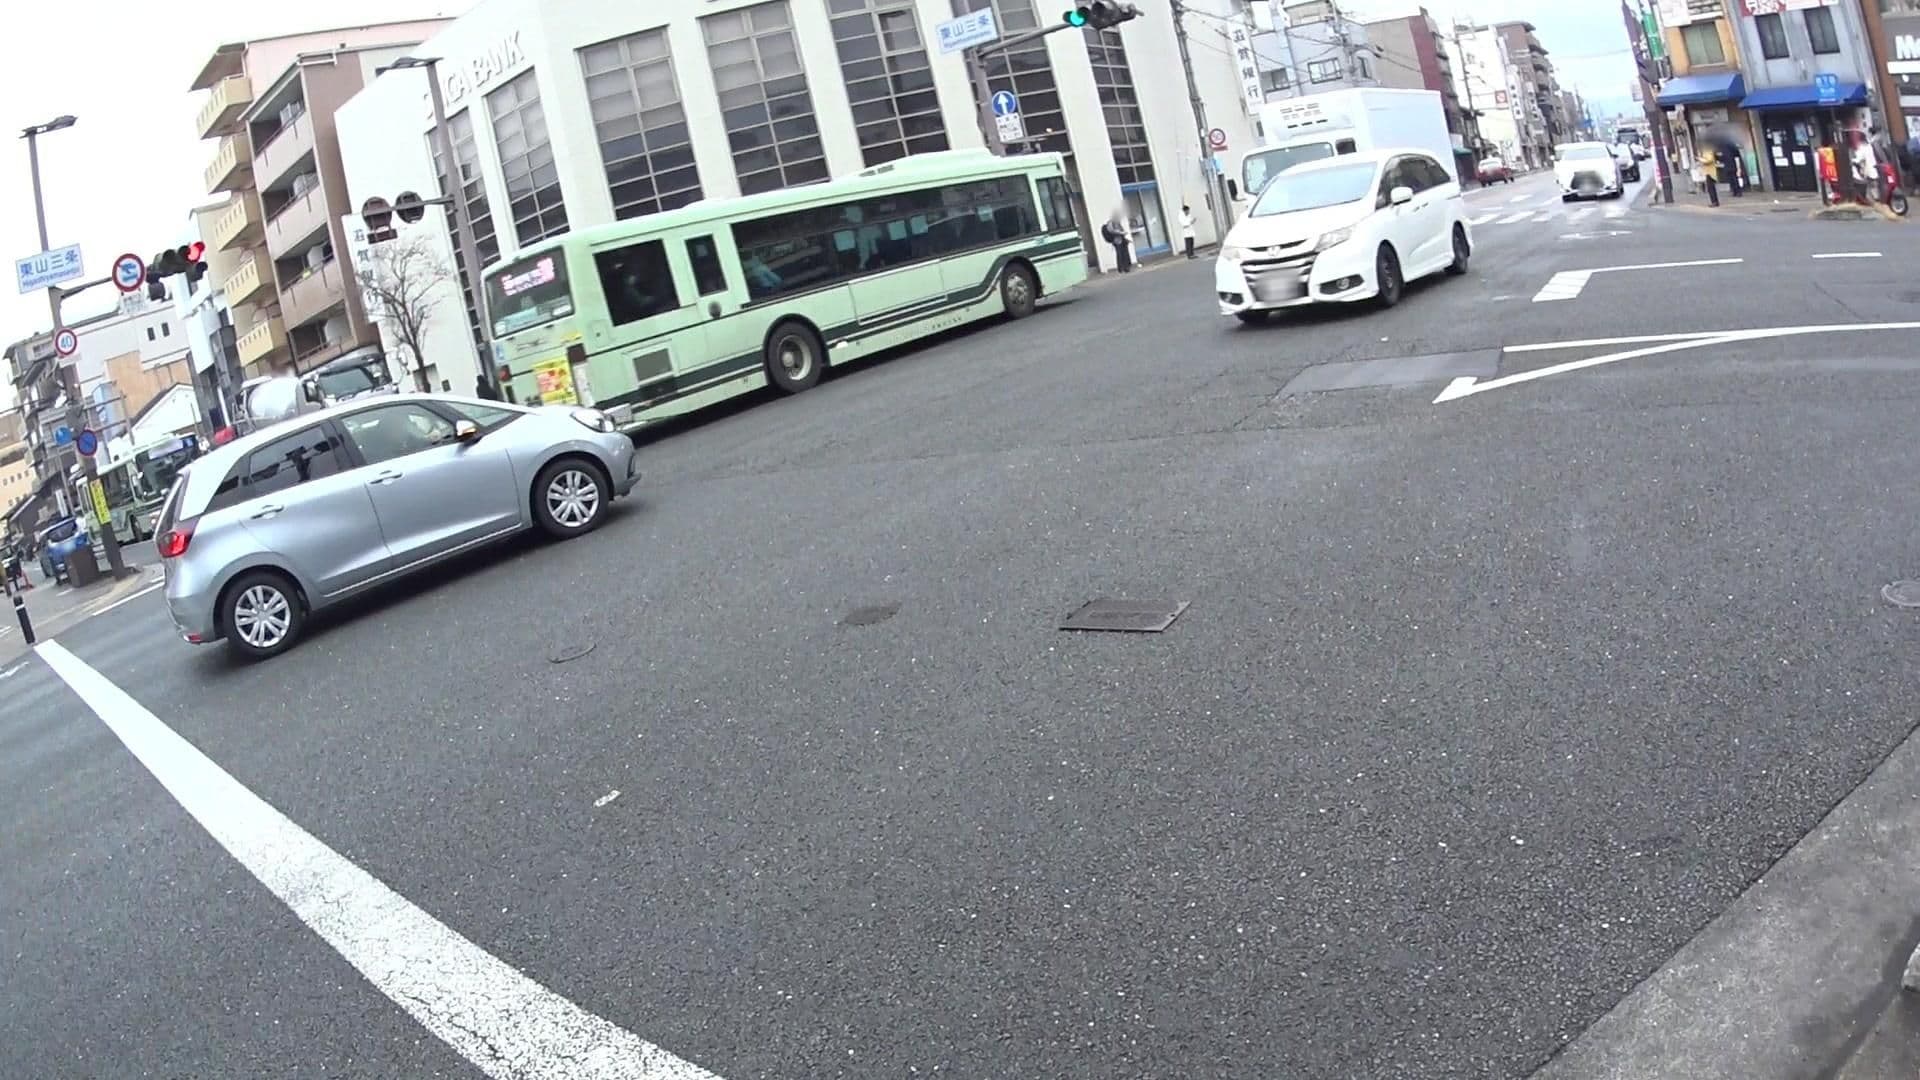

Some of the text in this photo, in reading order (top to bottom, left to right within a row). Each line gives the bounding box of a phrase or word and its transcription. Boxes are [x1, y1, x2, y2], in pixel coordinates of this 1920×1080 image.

[472, 29, 525, 88] BANK
[20, 249, 79, 278] 東山三条
[60, 335, 73, 349] 40
